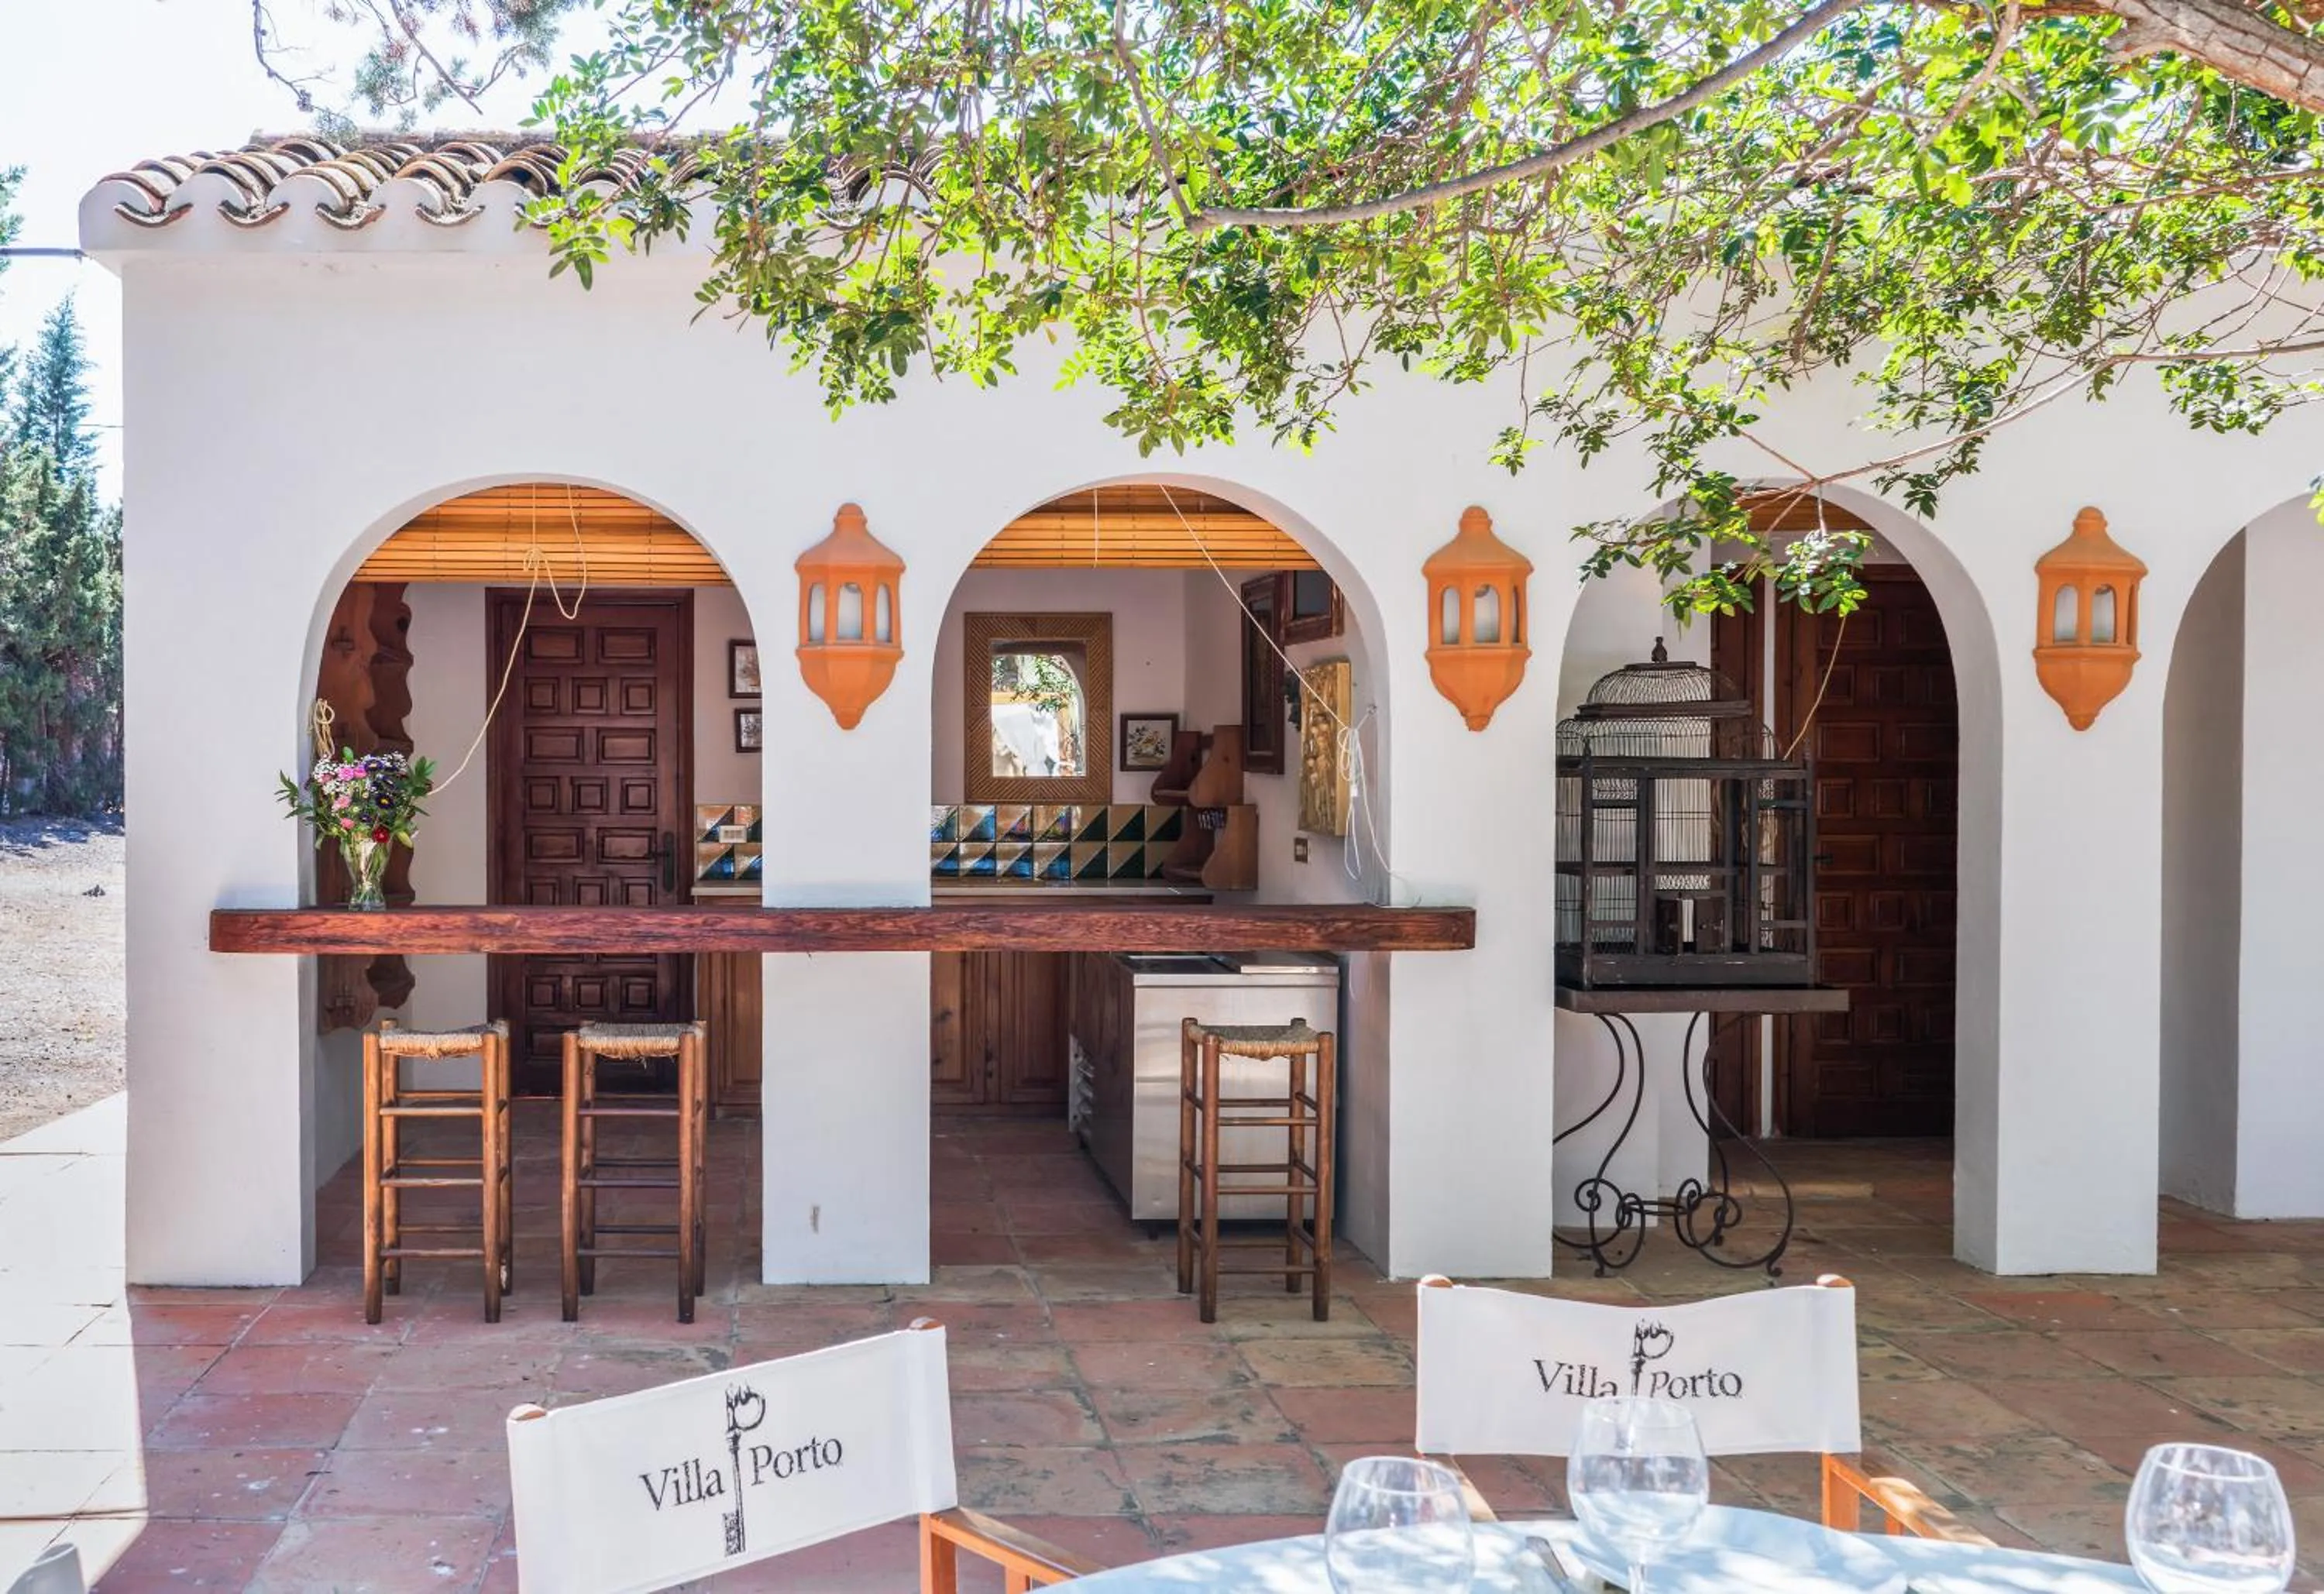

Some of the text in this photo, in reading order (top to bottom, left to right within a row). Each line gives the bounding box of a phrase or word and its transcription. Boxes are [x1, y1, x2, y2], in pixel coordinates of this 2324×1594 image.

[1533, 1359, 1743, 1400] Villa Porto
[638, 1436, 843, 1511] Villa Porto
